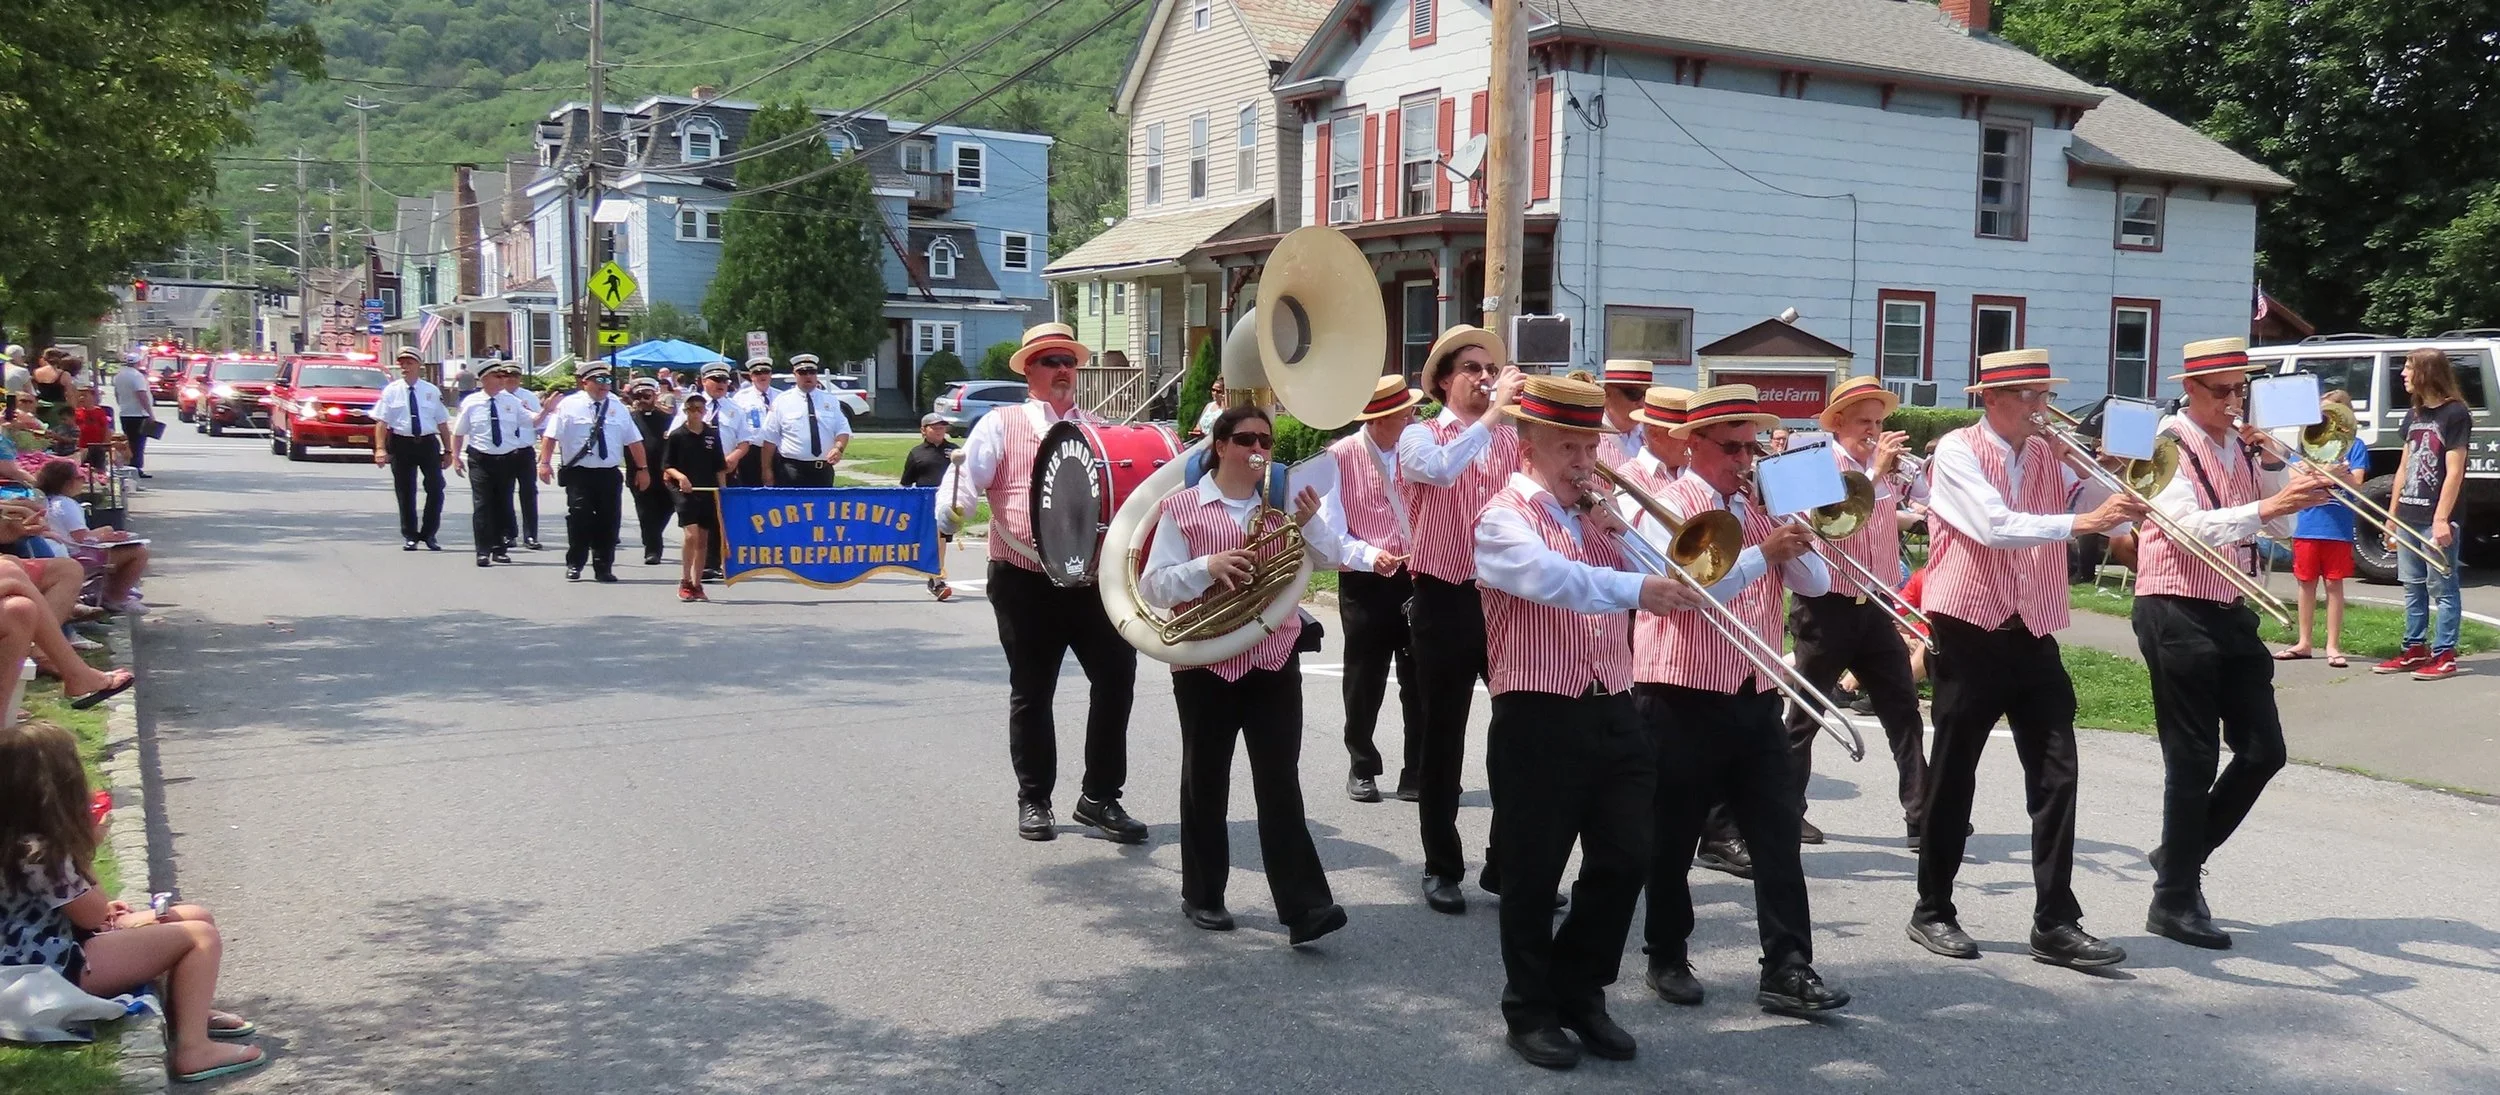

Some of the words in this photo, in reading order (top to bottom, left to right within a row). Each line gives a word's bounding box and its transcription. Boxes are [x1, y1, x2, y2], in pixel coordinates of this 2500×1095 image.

[1042, 451, 1061, 509] DIXIE
[1061, 439, 1099, 498] DANDIES
[2466, 458, 2499, 471] .M.C.
[751, 503, 814, 533] PORT
[828, 501, 911, 532] JERVIS
[813, 525, 851, 542] N.Y.
[738, 545, 784, 565] FIRE
[790, 542, 921, 565] DEPARTMENT
